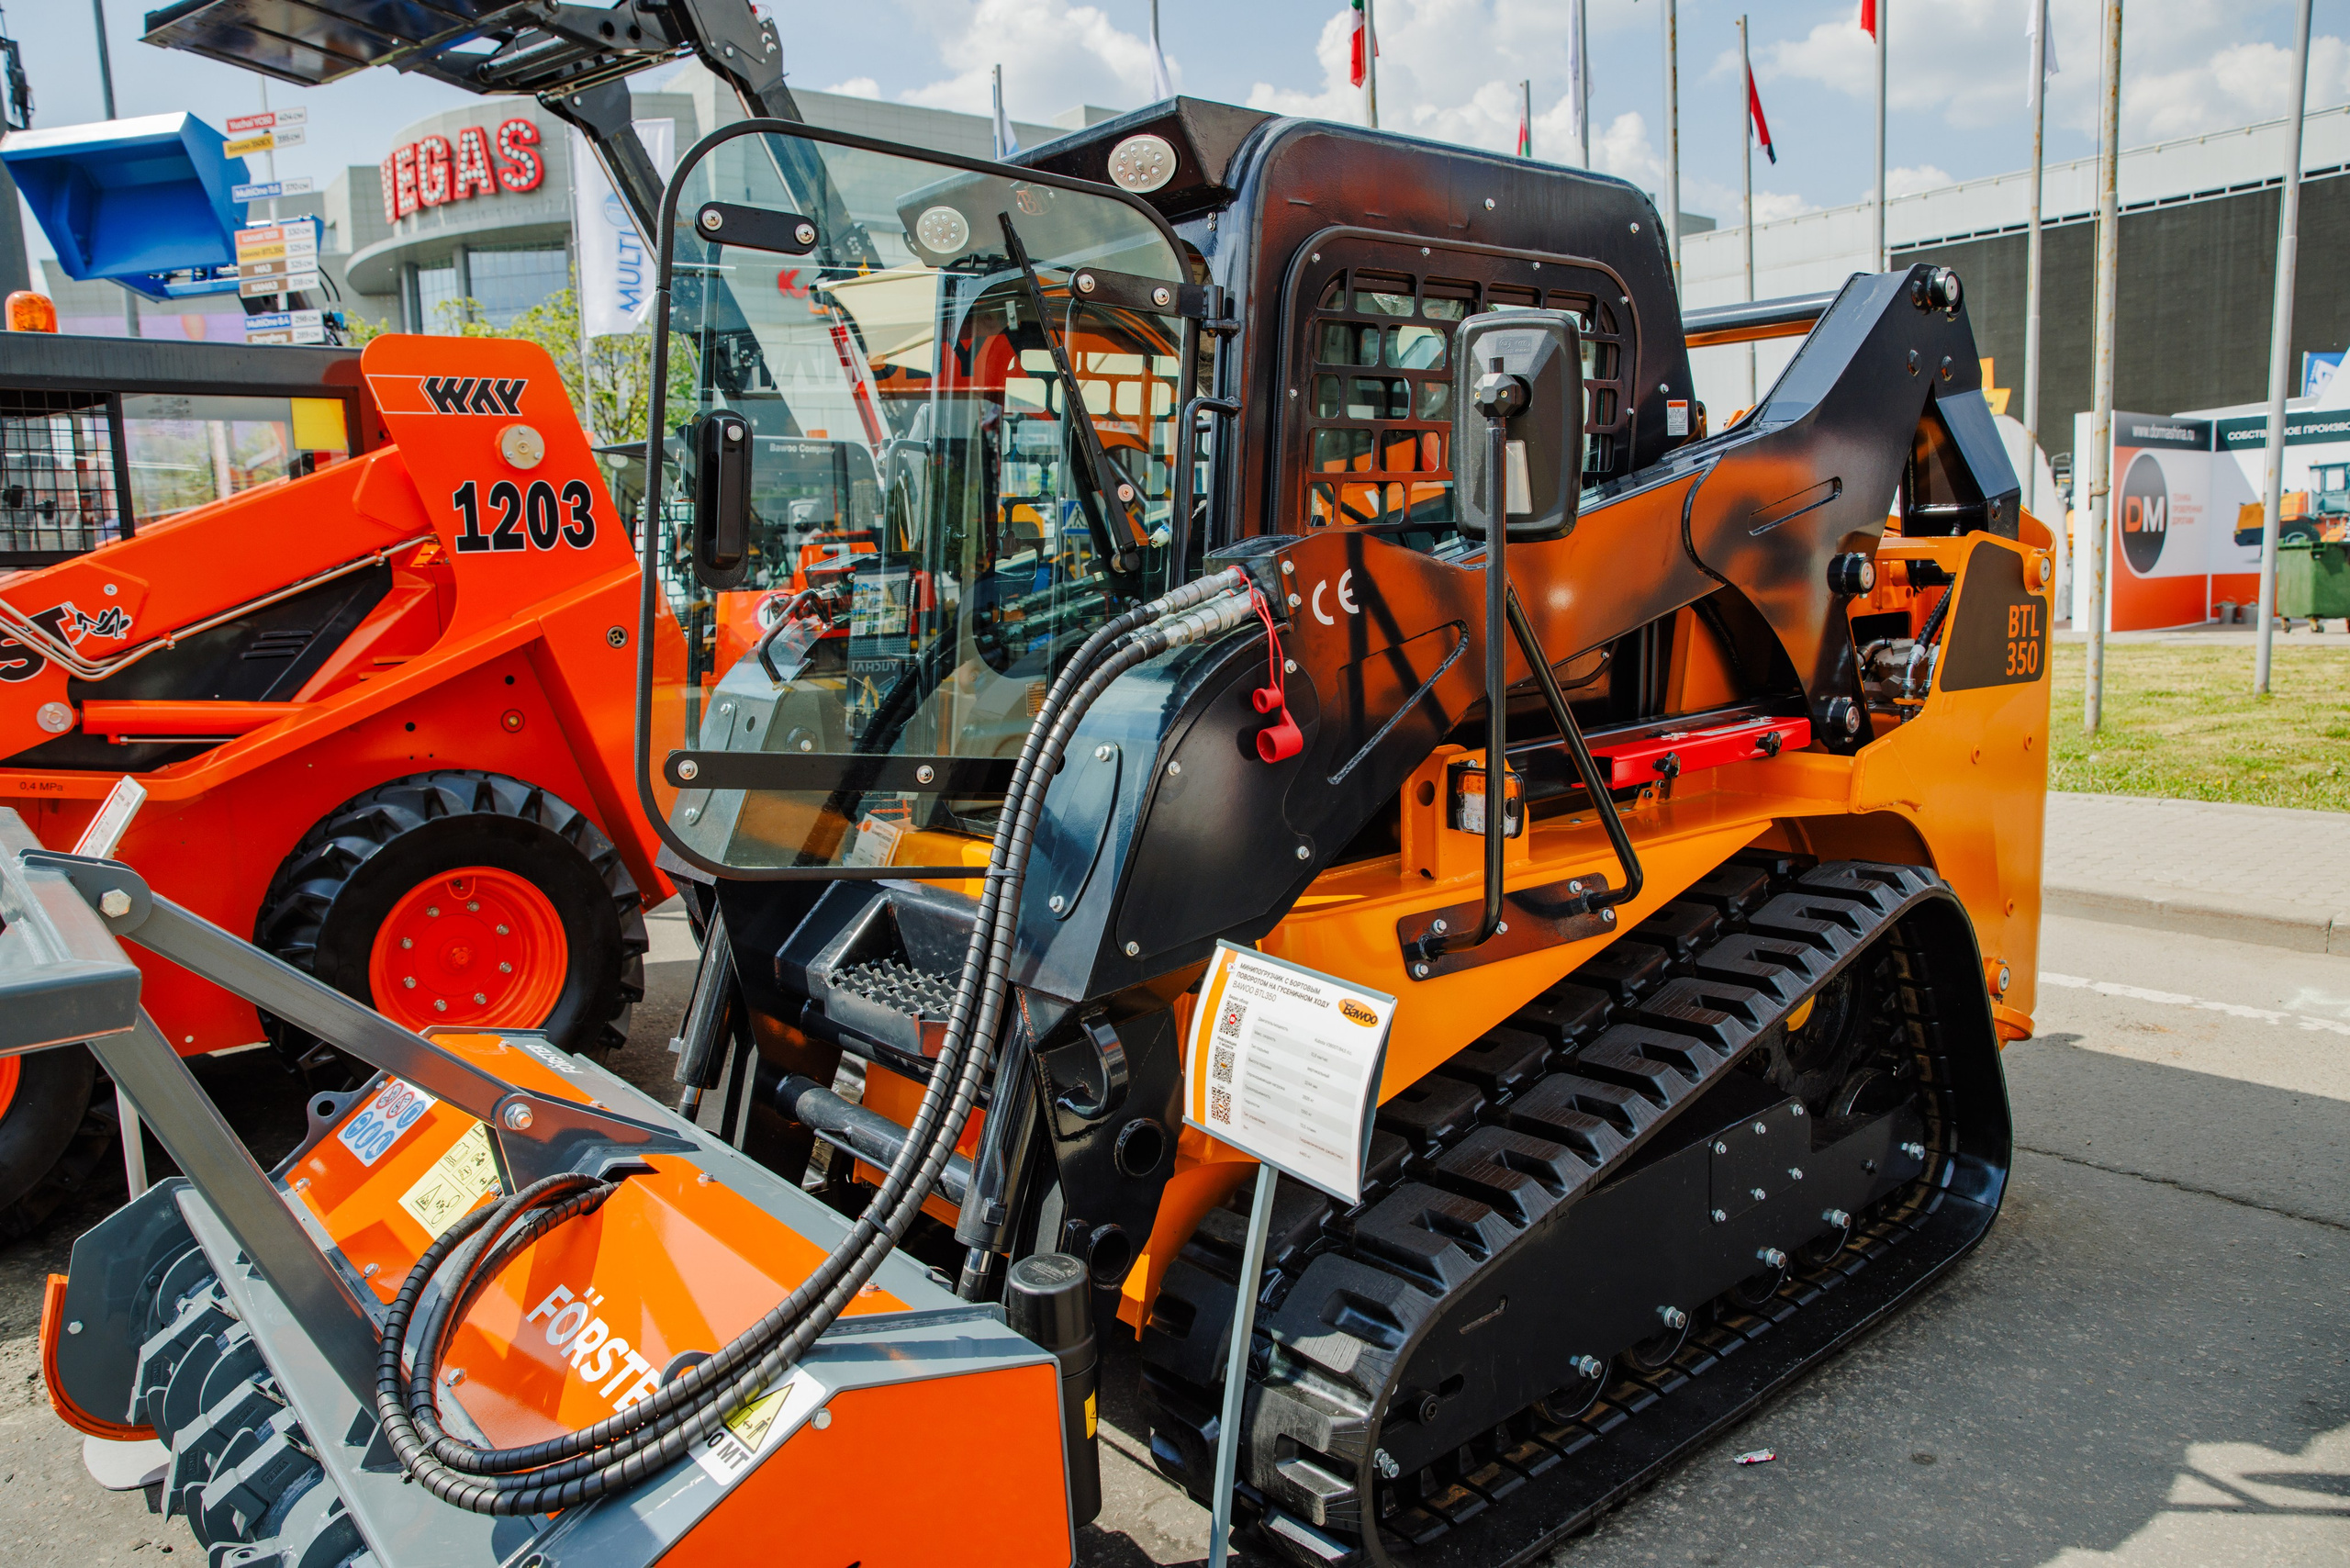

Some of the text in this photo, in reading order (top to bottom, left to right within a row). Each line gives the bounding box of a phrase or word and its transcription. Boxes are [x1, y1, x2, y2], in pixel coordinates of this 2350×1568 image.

[380, 118, 545, 224] VEGAS
[616, 231, 641, 312] MULTI
[423, 377, 529, 416] WAY
[769, 442, 798, 453] Bawoo
[2227, 426, 2301, 441] СОБСТВОЕ
[453, 479, 597, 554] 1203
[2125, 496, 2165, 532] DM
[1312, 568, 1360, 625] CE
[2008, 604, 2040, 638] BTL
[2006, 640, 2039, 676] 350
[39, 782, 63, 791] MPa
[1232, 980, 1277, 1002] BAWOO BTL350
[1236, 970, 1268, 987] ПОВОРОТОМ
[1277, 985, 1313, 1002] ГУСЕНИЧНОМ
[1314, 997, 1330, 1009] ХОДУ
[1239, 962, 1283, 983] МИНИПОГРУЗЧИК
[1290, 979, 1321, 994] БОРТОВЫМ
[1342, 999, 1378, 1025] Bawoo
[525, 1045, 584, 1074] FÖRSTER
[526, 1283, 661, 1412] FÖRSTE
[716, 1440, 750, 1470] MT
